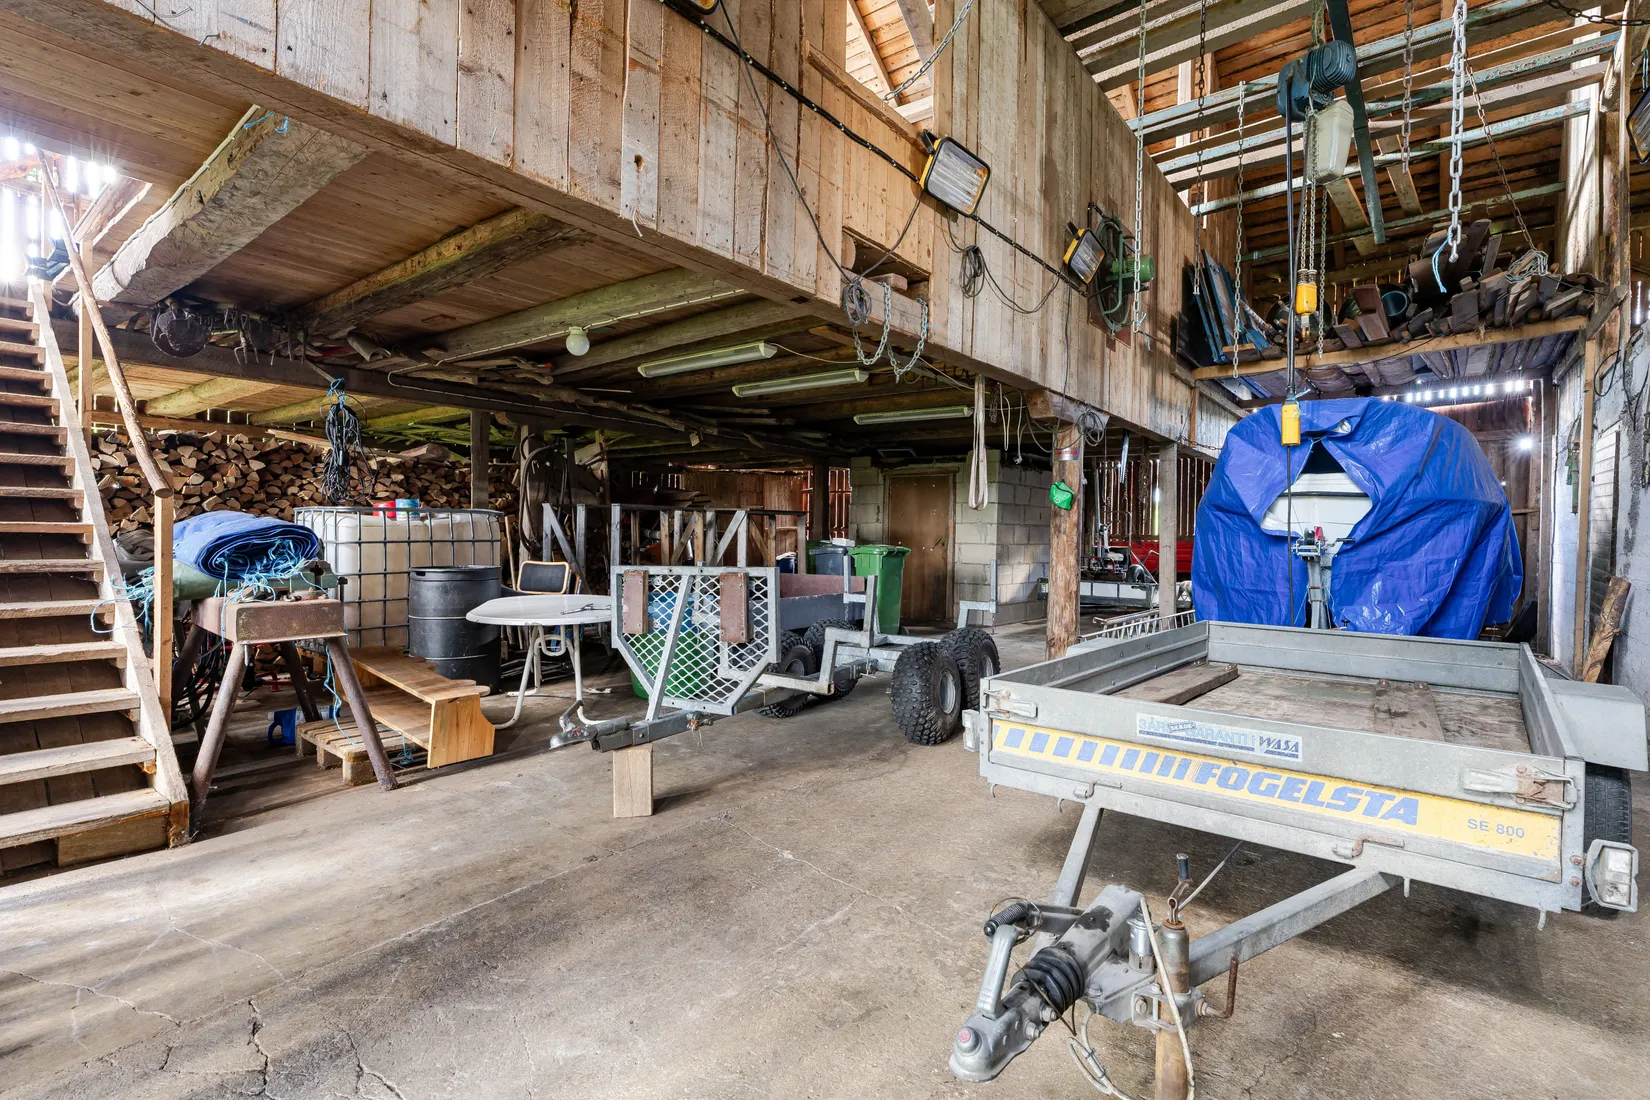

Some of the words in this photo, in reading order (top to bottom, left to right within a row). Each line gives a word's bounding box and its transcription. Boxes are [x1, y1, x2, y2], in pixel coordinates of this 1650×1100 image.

[1139, 719, 1147, 730] 3
[1258, 735, 1300, 753] WASA
[1193, 761, 1419, 825] FOGELSTA
[1467, 818, 1490, 832] SE
[1495, 823, 1525, 839] 800
